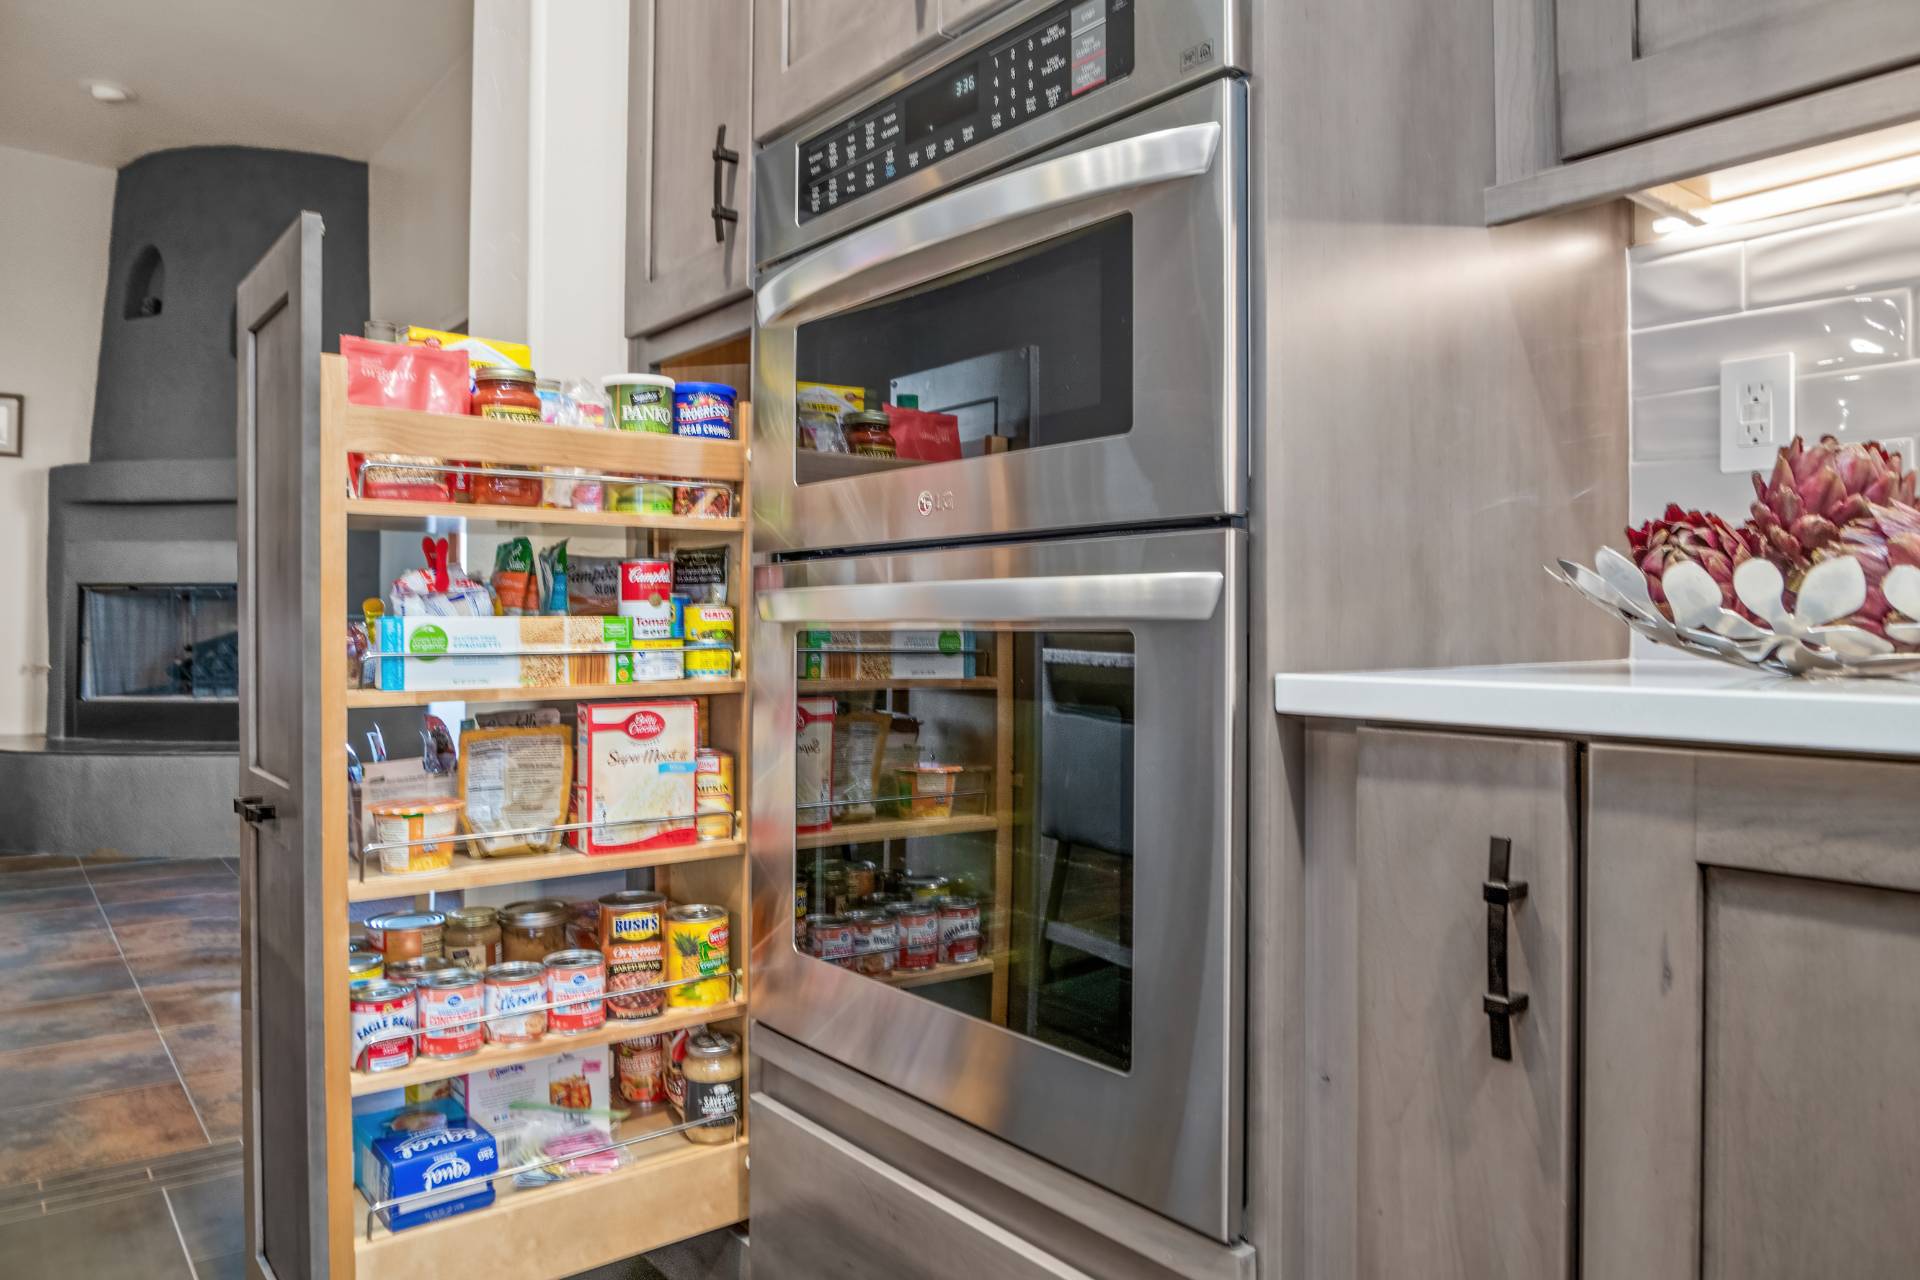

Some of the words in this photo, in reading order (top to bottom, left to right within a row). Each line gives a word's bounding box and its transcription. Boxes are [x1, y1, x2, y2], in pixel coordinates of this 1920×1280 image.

[622, 404, 671, 426] PANKO
[679, 404, 730, 422] PROGRESSO
[615, 916, 658, 933] BUSH'S
[613, 944, 661, 960] Original
[357, 1016, 389, 1041] EAGLE
[422, 1158, 472, 1192] equal
